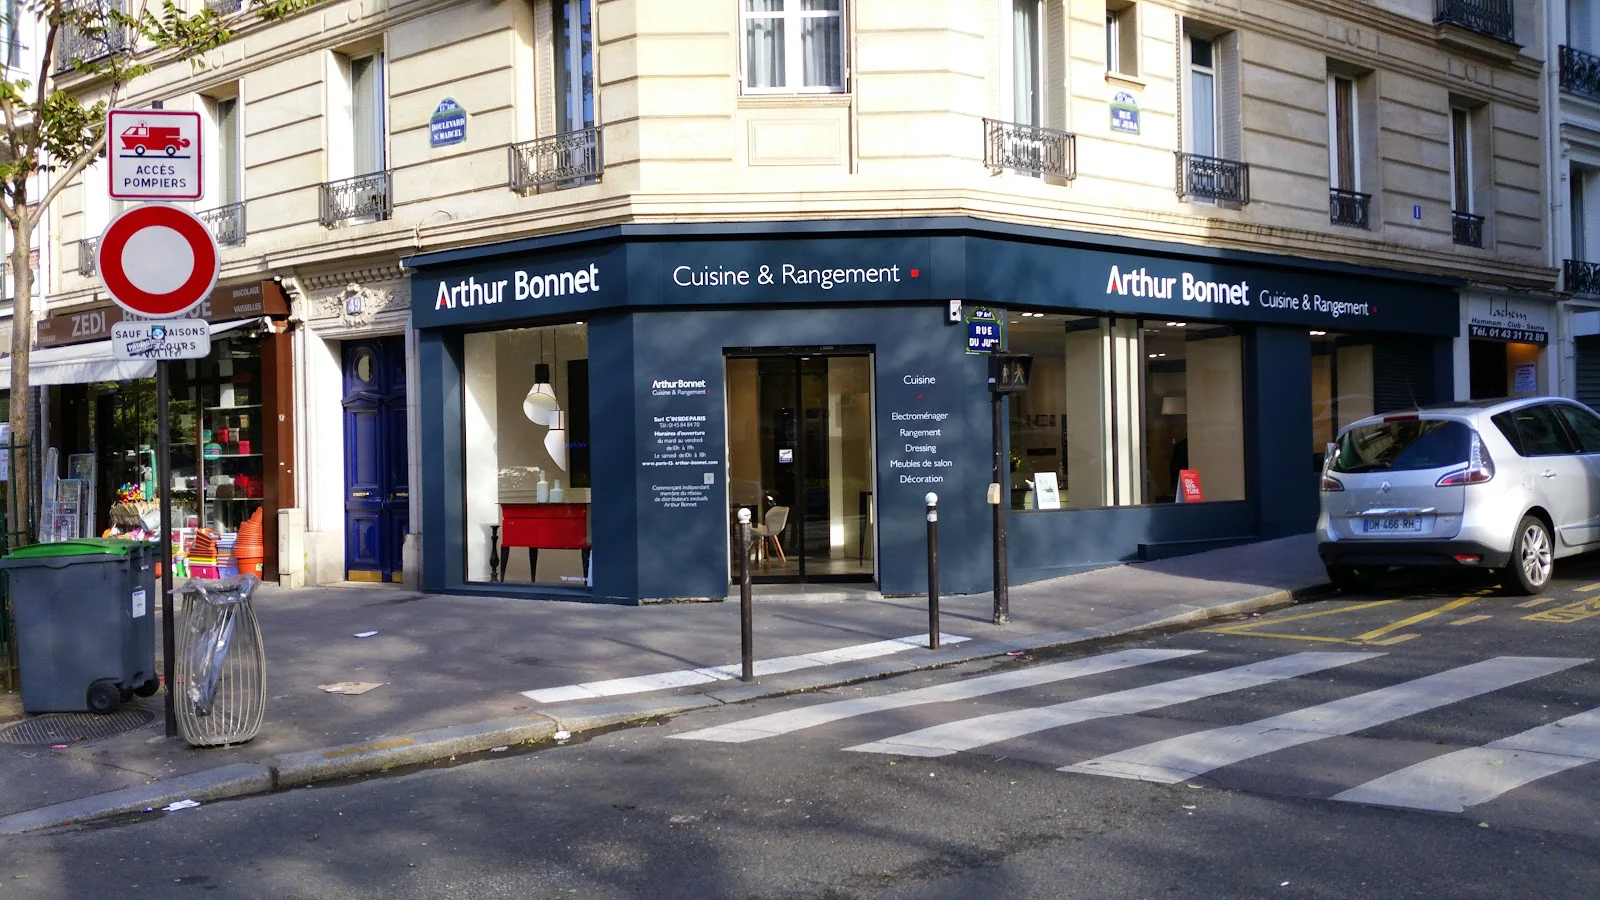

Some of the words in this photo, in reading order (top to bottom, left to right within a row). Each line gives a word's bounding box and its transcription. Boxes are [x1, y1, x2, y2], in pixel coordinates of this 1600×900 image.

[431, 117, 465, 132] BOULEVARD
[440, 129, 463, 140] MARCEL
[136, 164, 175, 175] ACCÈS
[124, 178, 186, 188] POMPIERS
[673, 265, 750, 286] Cuisine
[757, 264, 774, 285] &
[782, 264, 900, 290] Rangement
[435, 276, 508, 310] Arthur
[514, 263, 600, 301] Bonnet
[1106, 265, 1177, 299] Arthur
[1182, 272, 1250, 306] Bonnet
[1260, 290, 1300, 310] Cuisine
[1302, 294, 1312, 310] &
[1314, 294, 1370, 318] Rangement
[232, 286, 260, 298] BRICOLAGE
[234, 303, 262, 313] VAISSELLES
[72, 311, 106, 337] ZEDI
[1472, 317, 1502, 326] Hammam
[1526, 323, 1545, 331] Sauna
[116, 330, 142, 339] SAUF
[976, 326, 992, 336] RUE
[1472, 326, 1487, 336] Tél.
[1489, 328, 1500, 337] 01
[1501, 330, 1512, 338] 43
[1513, 330, 1522, 339] 31
[1524, 332, 1534, 341] 72
[1535, 333, 1545, 342] 89
[152, 342, 196, 350] ECOURS
[969, 338, 979, 347] DU
[652, 380, 678, 388] Arthur
[678, 380, 706, 388] Bonnet
[903, 375, 936, 384] Cuisine
[891, 412, 948, 422] Electroménager
[900, 428, 942, 438] Rangement
[906, 444, 937, 454] Dressing
[890, 460, 920, 468] Meubles
[922, 459, 932, 467] de
[934, 459, 953, 467] salon
[900, 474, 944, 484] Décoration
